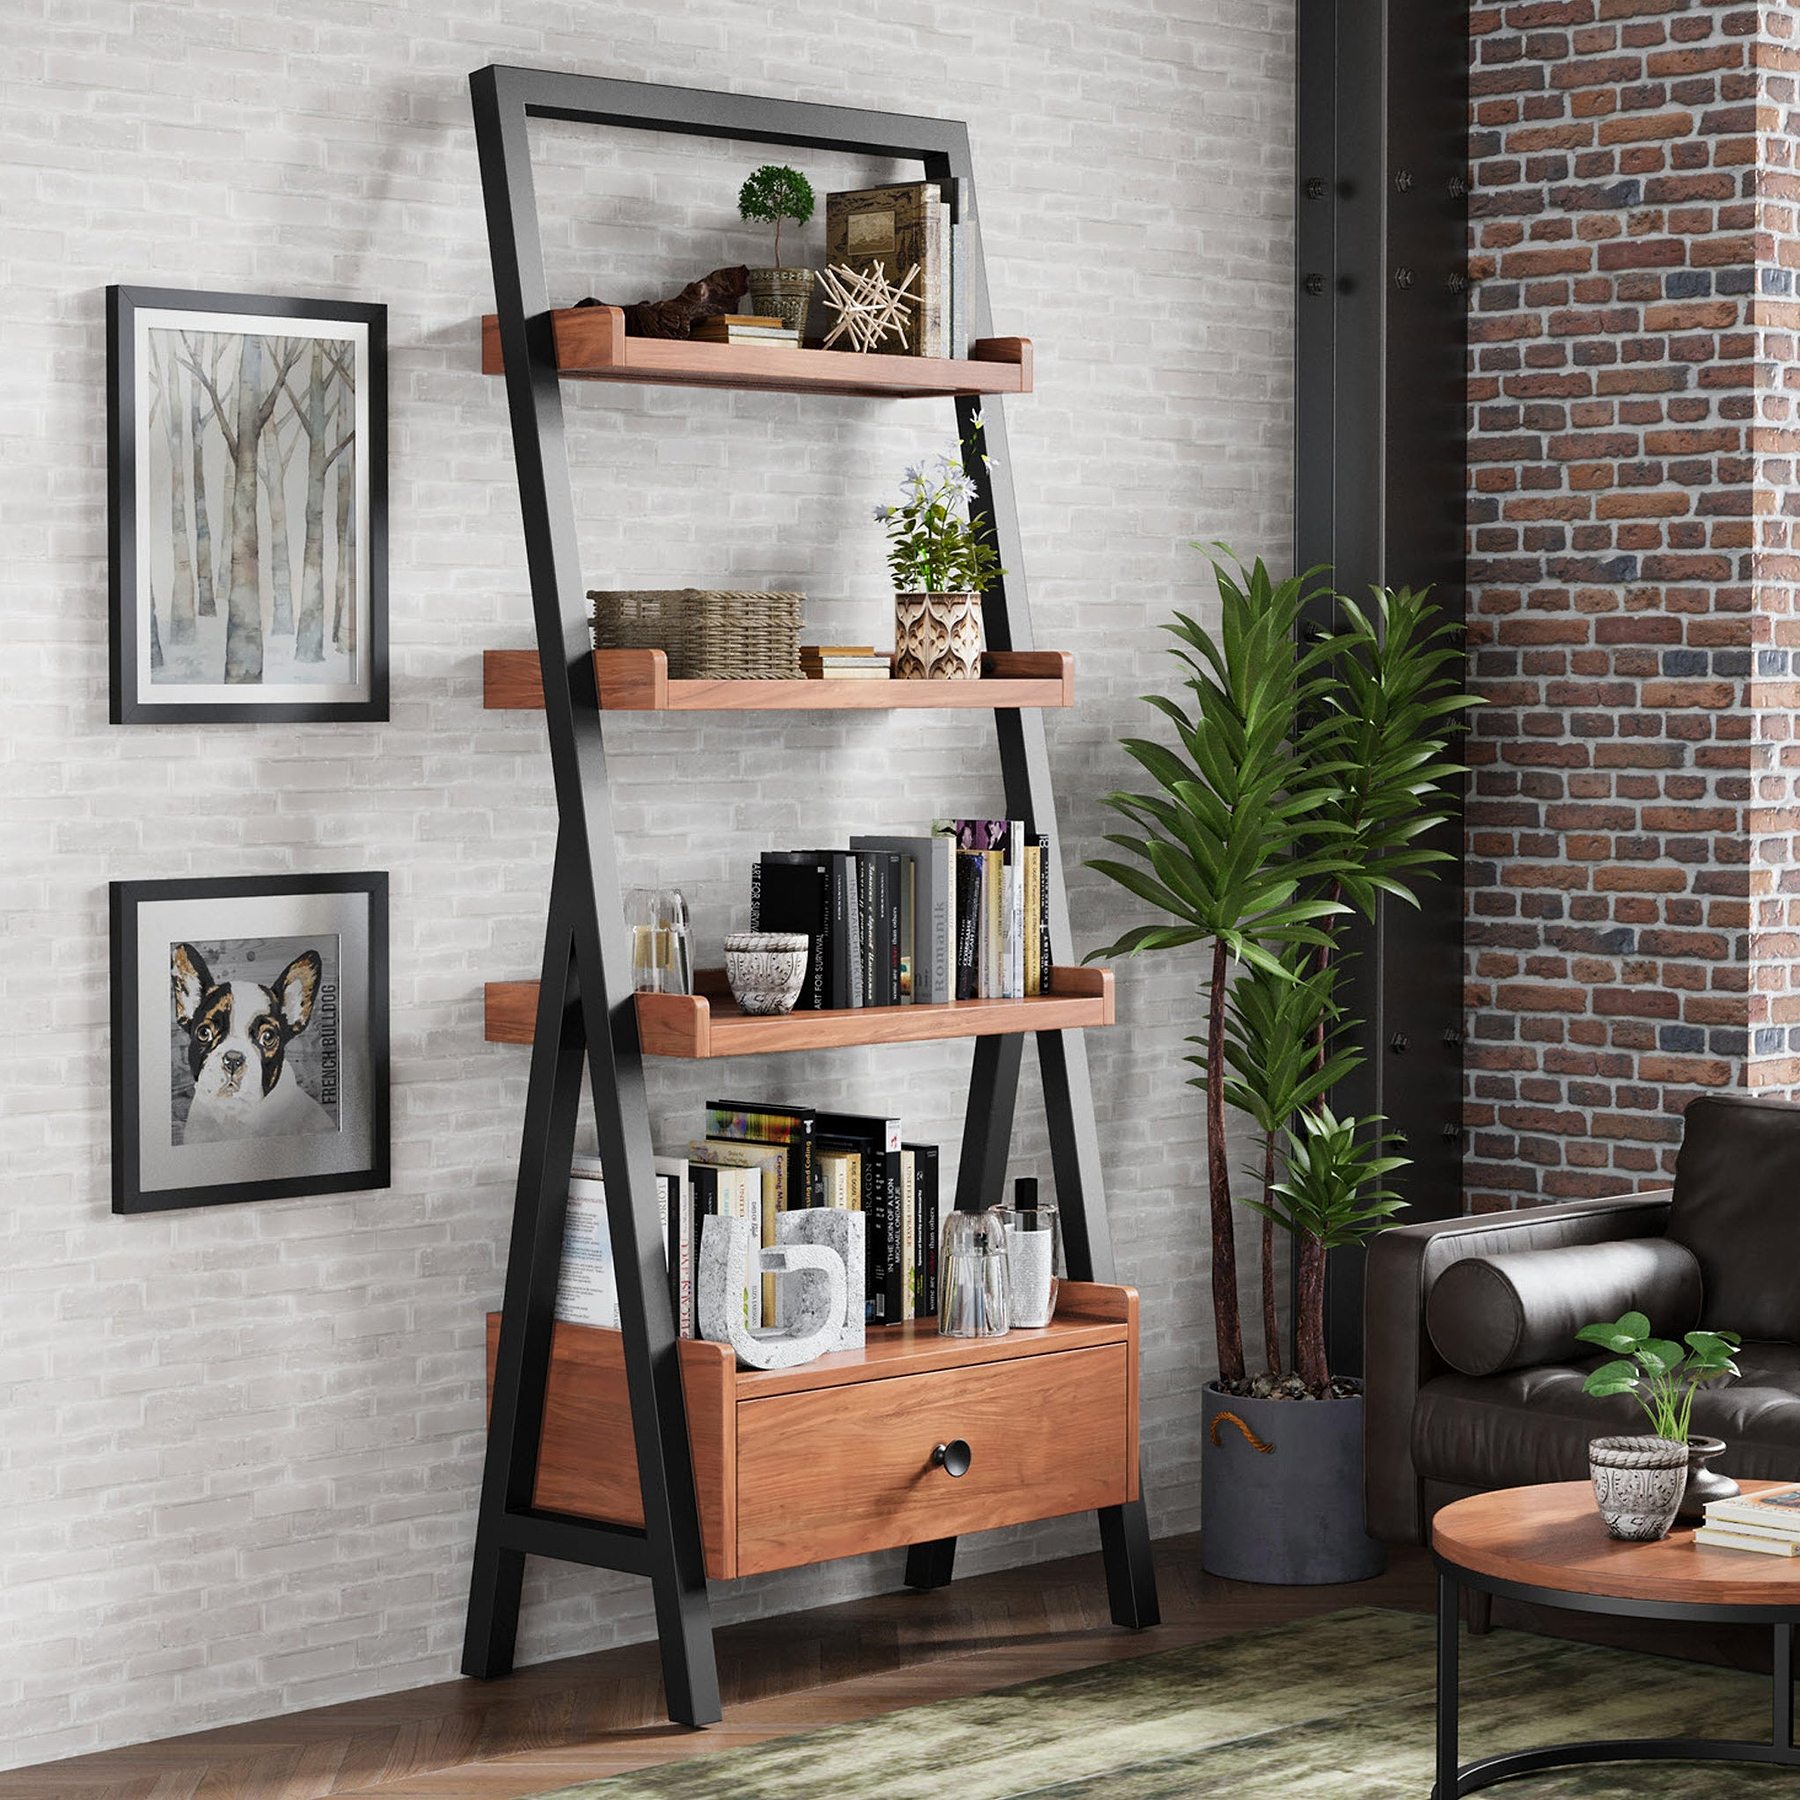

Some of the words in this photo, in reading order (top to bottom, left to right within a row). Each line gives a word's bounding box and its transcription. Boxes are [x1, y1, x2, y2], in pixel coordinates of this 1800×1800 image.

[751, 863, 761, 878] ART
[751, 881, 761, 899] FOR
[849, 879, 861, 999] INNENARCHITEKTUR
[934, 901, 945, 992] Romanik
[815, 934, 824, 971] SURVIVAL
[814, 974, 823, 991] FOR
[814, 994, 822, 1009] ART
[322, 984, 336, 1048] BULLDOG
[322, 1049, 336, 1105] FRENCH
[888, 1208, 894, 1221] OF
[888, 1263, 894, 1273] IN
